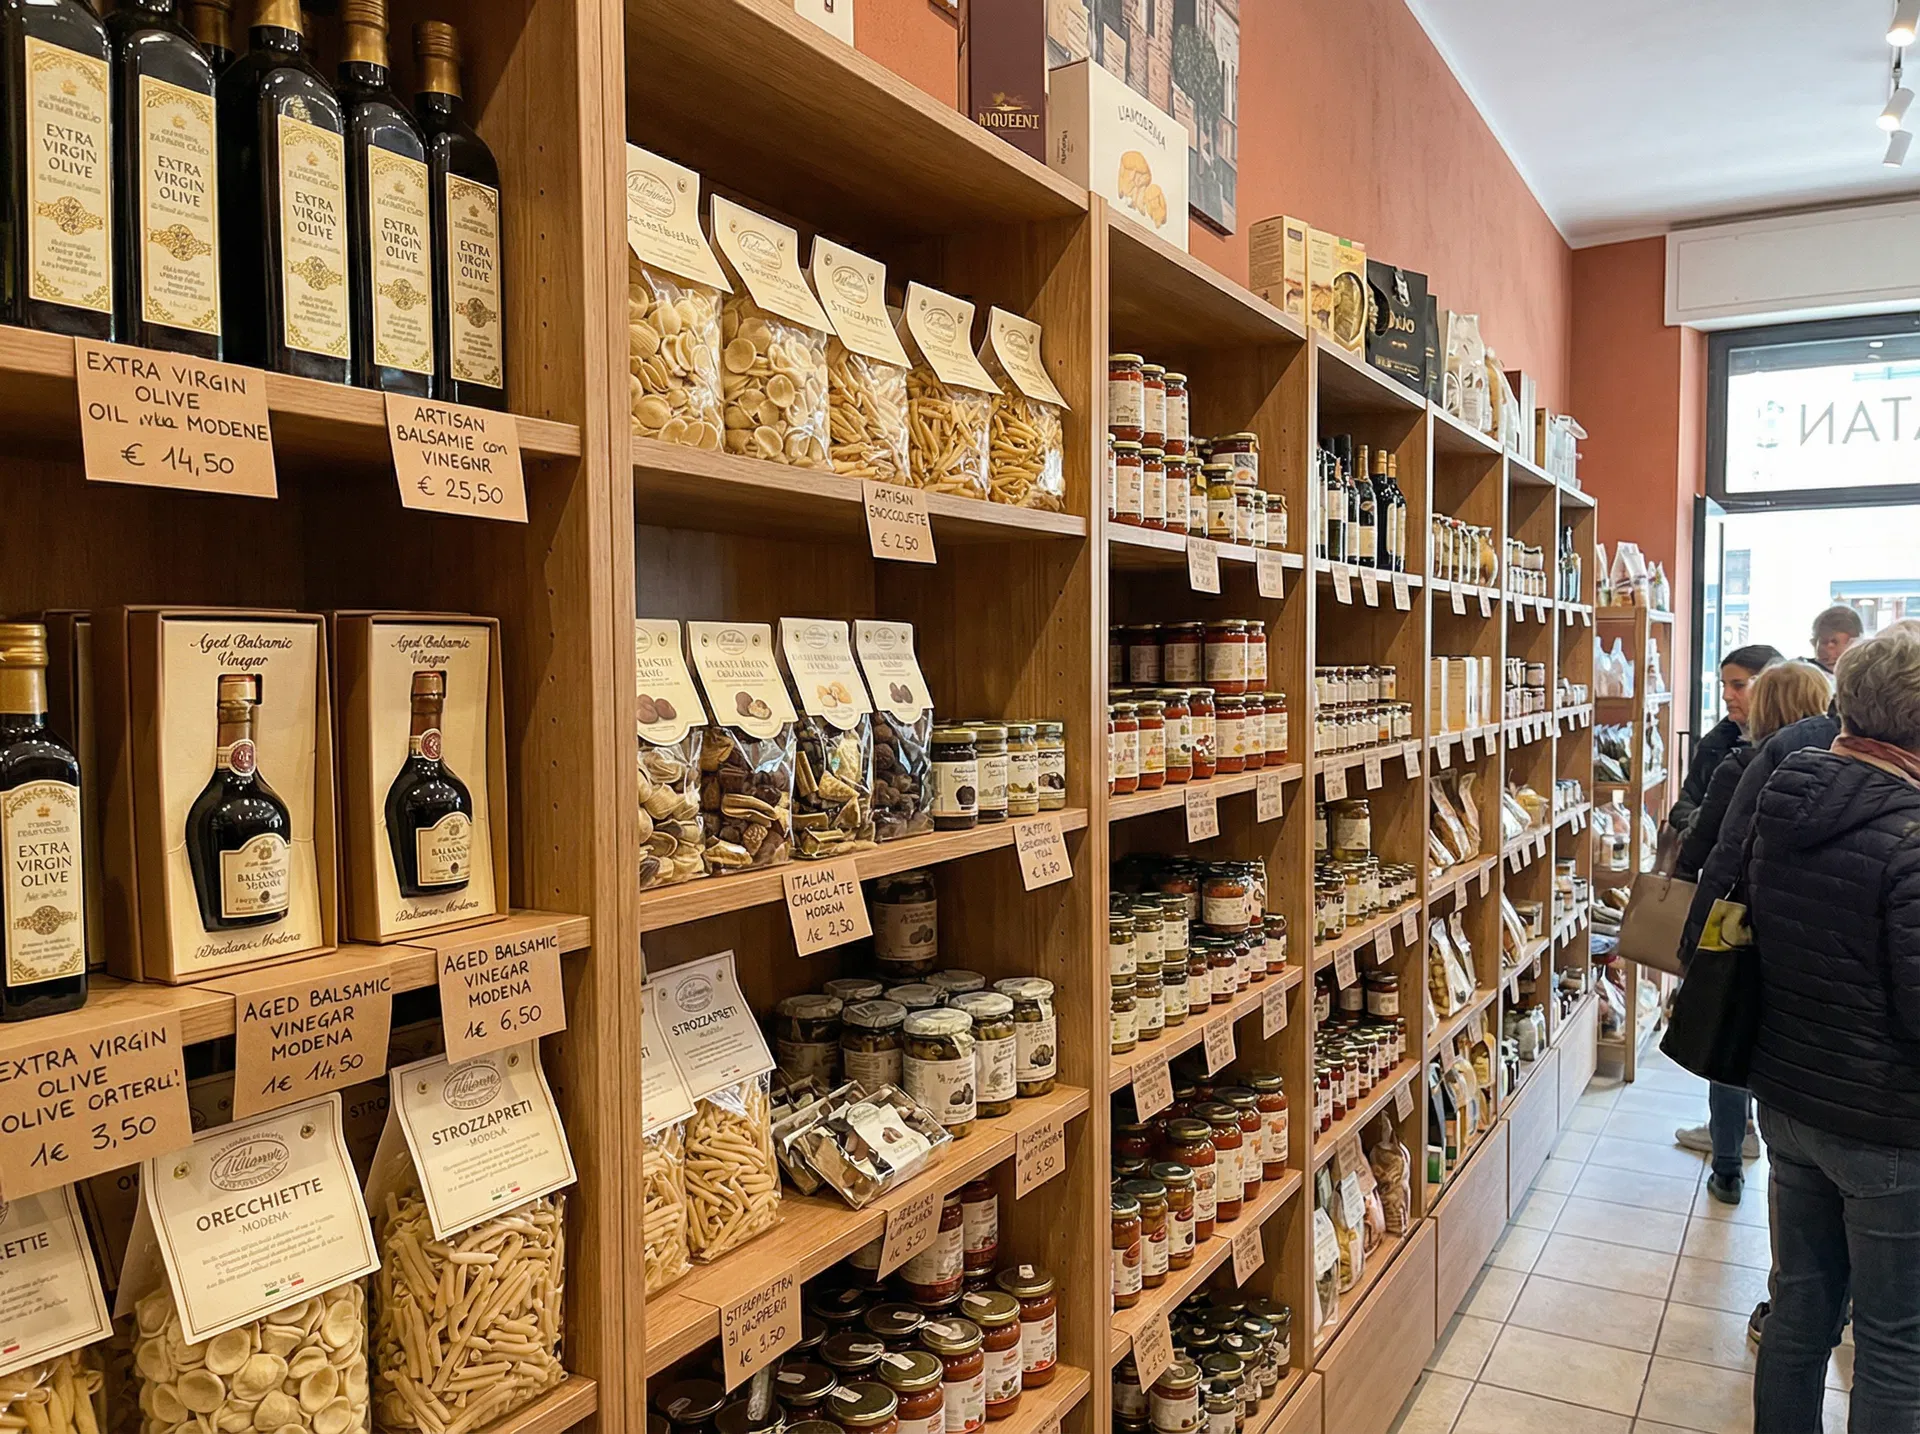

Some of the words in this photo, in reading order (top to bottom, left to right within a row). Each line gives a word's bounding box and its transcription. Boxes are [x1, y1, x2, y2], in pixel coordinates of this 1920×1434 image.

[46, 122, 94, 148] EXTRA
[42, 138, 97, 164] VIRGIN
[48, 157, 93, 179] OLIVE
[158, 155, 202, 178] EXTRA
[153, 169, 205, 194] VIRGIN
[159, 186, 201, 209] OLIVE
[295, 191, 334, 213] EXTRA
[292, 204, 337, 227] VIRGIN
[383, 217, 419, 237] EXTRA
[297, 221, 333, 241] OLIVE
[381, 231, 422, 251] VIRGIN
[386, 245, 419, 264] OLIVE
[460, 239, 491, 258] EXTRA
[457, 252, 493, 271] VIRGIN
[461, 266, 490, 283] OLIVE
[87, 351, 162, 382] EXTRA
[172, 366, 246, 395] VIRGIN
[135, 385, 200, 410] OLIVE
[88, 402, 129, 424] OIL
[187, 415, 269, 441] MODENE
[414, 406, 485, 433] ARTISAN
[396, 424, 475, 451] BALSAMIE
[482, 441, 508, 455] con
[120, 442, 146, 466] €
[161, 446, 235, 477] 14,50
[421, 450, 493, 474] VINEGNR
[417, 475, 435, 496] €
[445, 478, 504, 505] 25,50
[874, 488, 913, 506] ARTISAN
[880, 532, 891, 548] €
[894, 533, 919, 552] 2,50
[190, 633, 232, 654] Aged
[233, 633, 293, 649] Balsamic
[391, 634, 422, 653] Aged
[423, 634, 471, 649] Balsamic
[217, 651, 269, 671] Vinegar
[410, 650, 451, 668] Vinegar
[19, 841, 70, 858] EXTRA
[16, 855, 72, 872] VIRGIN
[21, 870, 69, 888] OLIVE
[791, 868, 835, 890] ITALIAN
[791, 881, 854, 907] CHOCOLATE
[828, 918, 854, 937] 2,50
[444, 949, 488, 975] AGED
[495, 935, 558, 960] BALSAMIC
[464, 960, 529, 988] VINEGAR
[243, 996, 299, 1023] AGED
[310, 977, 391, 1007] BALSAMIC
[469, 979, 532, 1008] MODENA
[270, 1005, 355, 1039] VINEGAR
[500, 1005, 542, 1031] 6,50
[0, 1047, 78, 1082] EXTRA
[89, 1027, 167, 1059] VIRGIN
[271, 1027, 353, 1062] MODENA
[304, 1053, 364, 1081] 14,50
[38, 1065, 108, 1098] OLIVE
[1, 1099, 75, 1134] OLIVE
[431, 1099, 534, 1146] STROZZAPRETI
[91, 1116, 157, 1150] 3,50
[196, 1177, 324, 1233] ORECCHIETTE
[0, 1231, 49, 1260] ETTE
